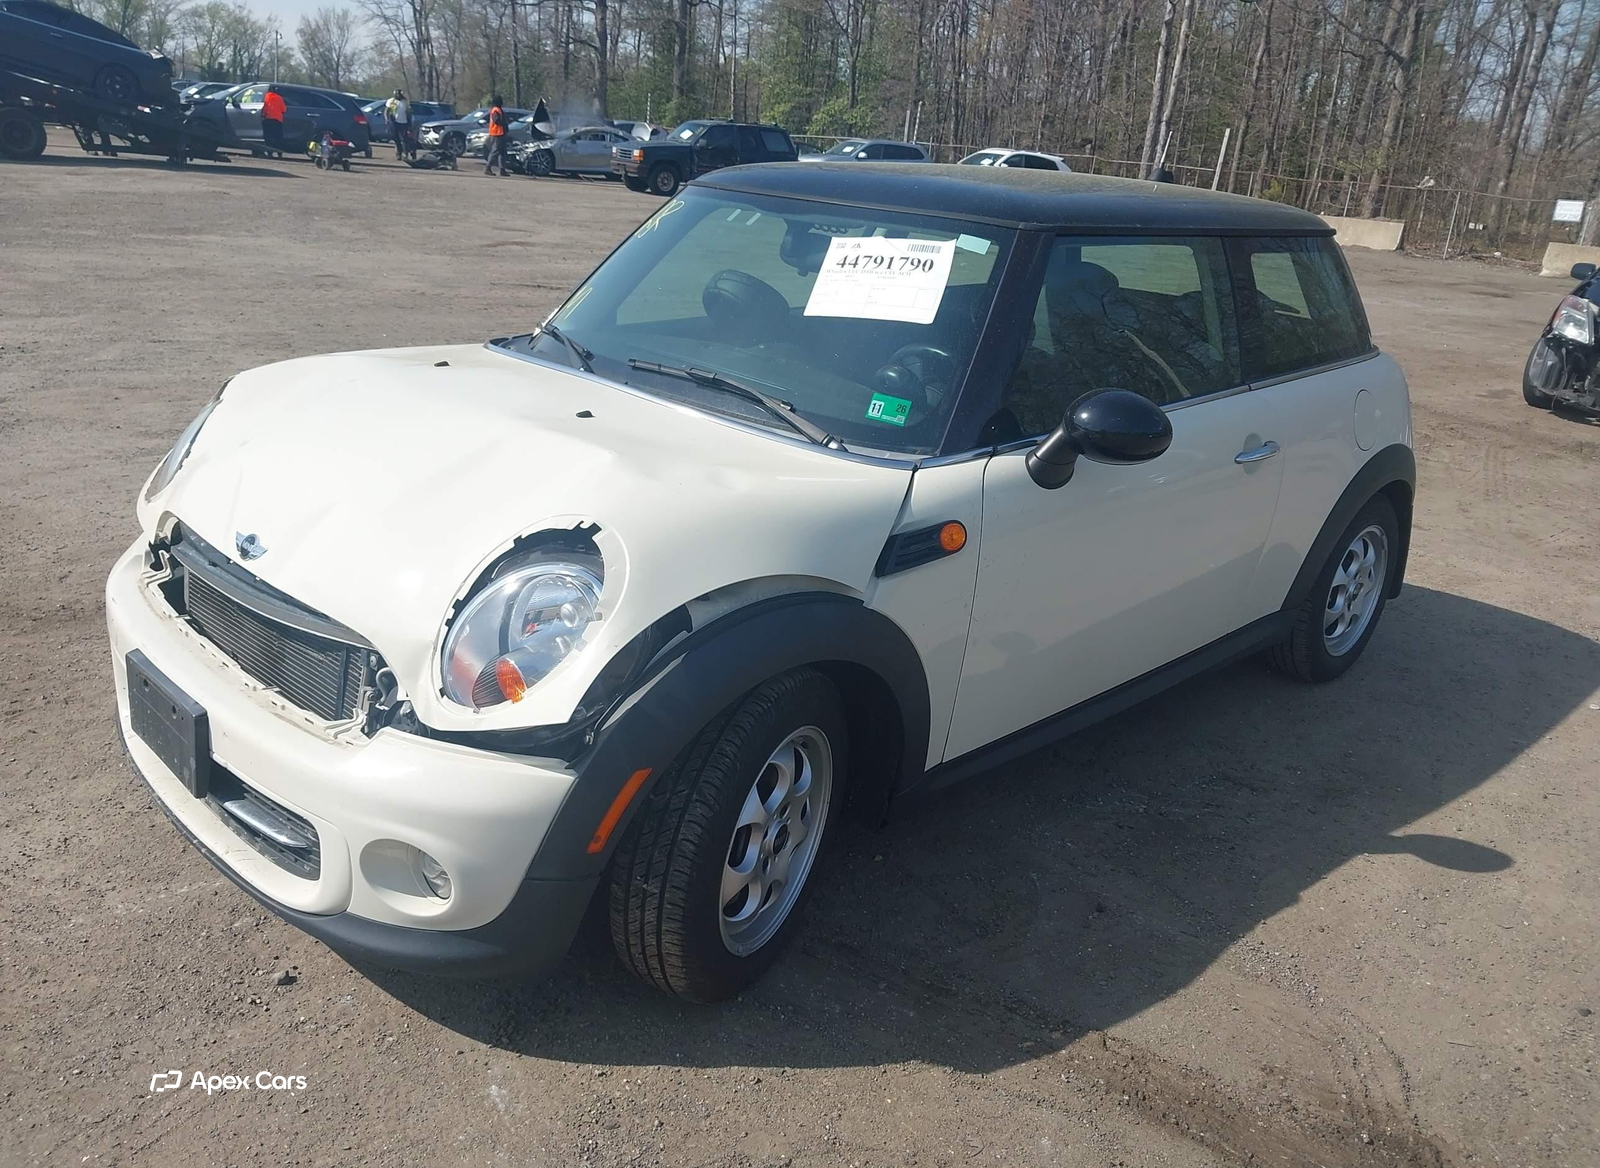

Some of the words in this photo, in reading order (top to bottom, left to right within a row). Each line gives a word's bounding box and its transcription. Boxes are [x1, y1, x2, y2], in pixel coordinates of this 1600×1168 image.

[836, 254, 934, 273] 44791790
[871, 402, 882, 414] 11
[895, 403, 907, 413] 26
